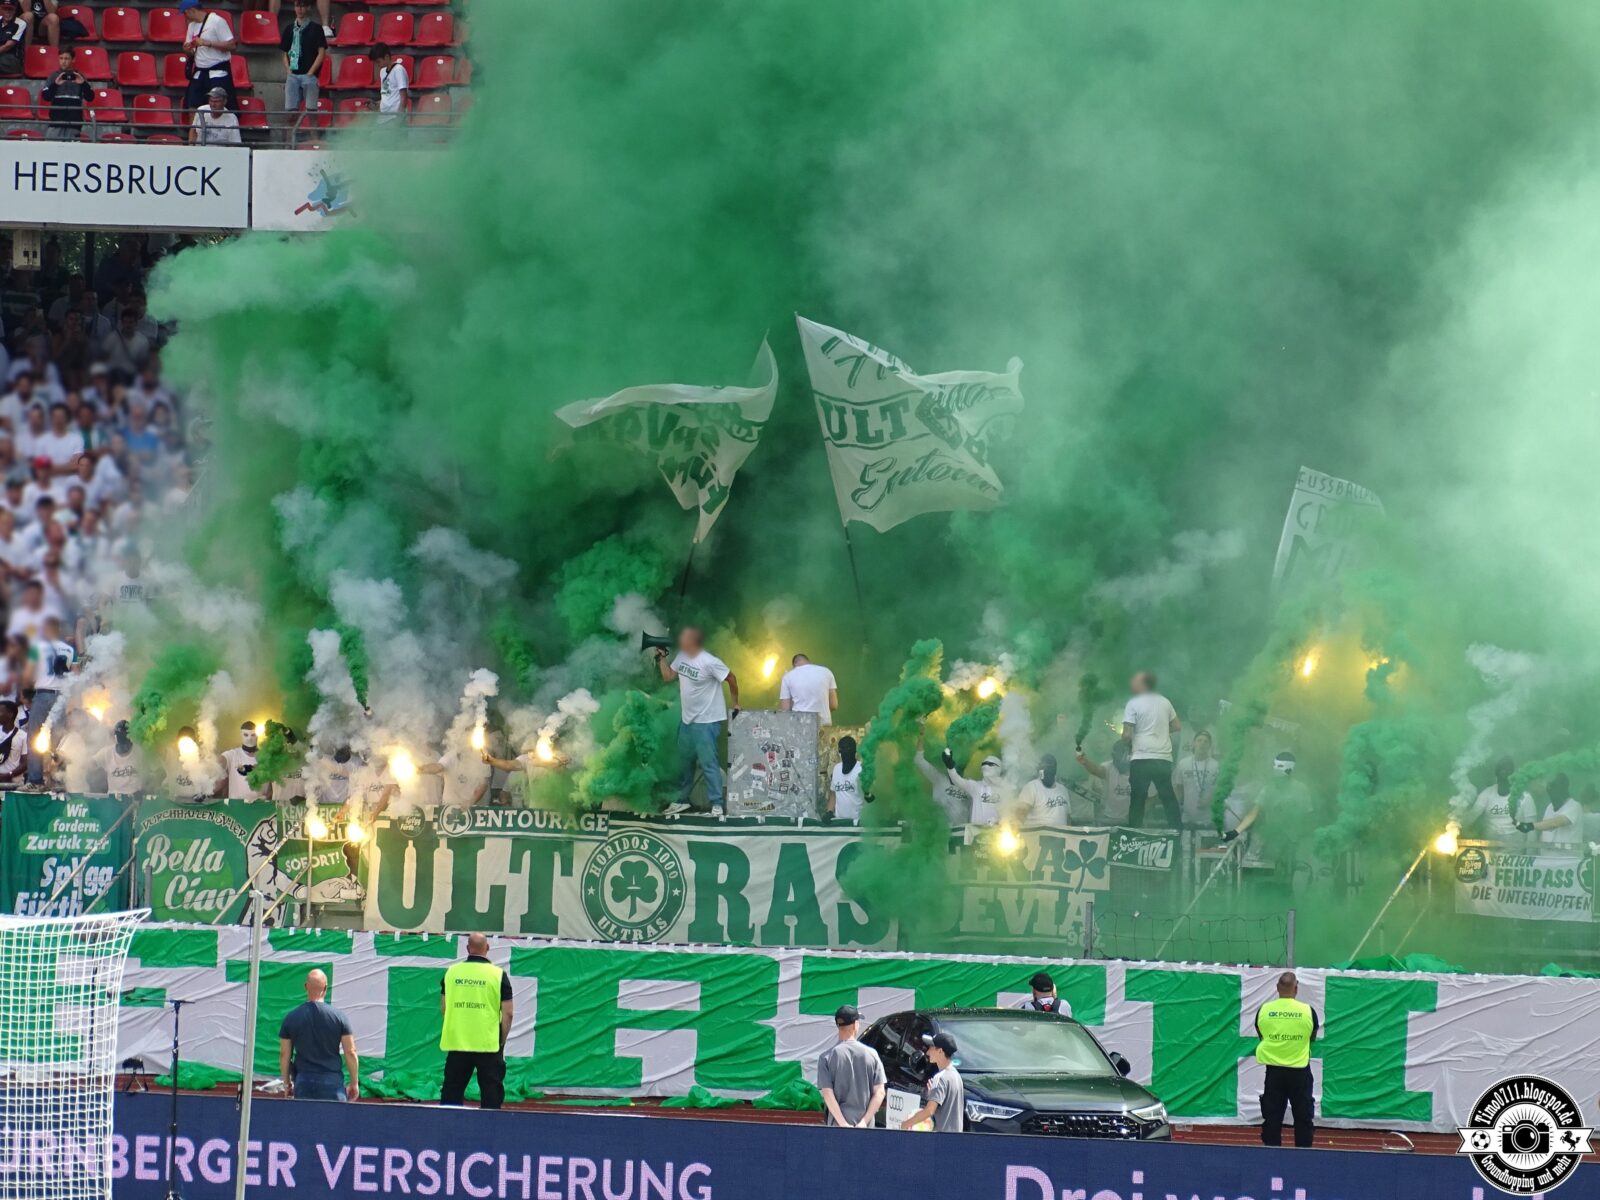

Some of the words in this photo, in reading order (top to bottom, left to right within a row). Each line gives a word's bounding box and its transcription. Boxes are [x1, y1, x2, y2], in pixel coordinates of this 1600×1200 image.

[14, 161, 222, 197] HERSBRUCK
[66, 803, 88, 818] Wir
[474, 807, 609, 833] ENTOURAGE
[53, 819, 100, 833] fordern:
[26, 833, 83, 851] Zurück
[142, 833, 225, 875] Bella
[285, 851, 340, 874] SOFORT!
[589, 836, 651, 878] HORIDOS
[654, 846, 679, 879] 1000
[40, 856, 114, 898] SpVgg
[1495, 868, 1575, 889] FEHLPASS
[164, 874, 238, 912] Ciao
[1471, 885, 1493, 900] DIE
[1498, 889, 1592, 910] UNTERHOPFTEN
[597, 915, 668, 942] ULTRAS
[315, 1143, 713, 1200] VERSICHERUNG
